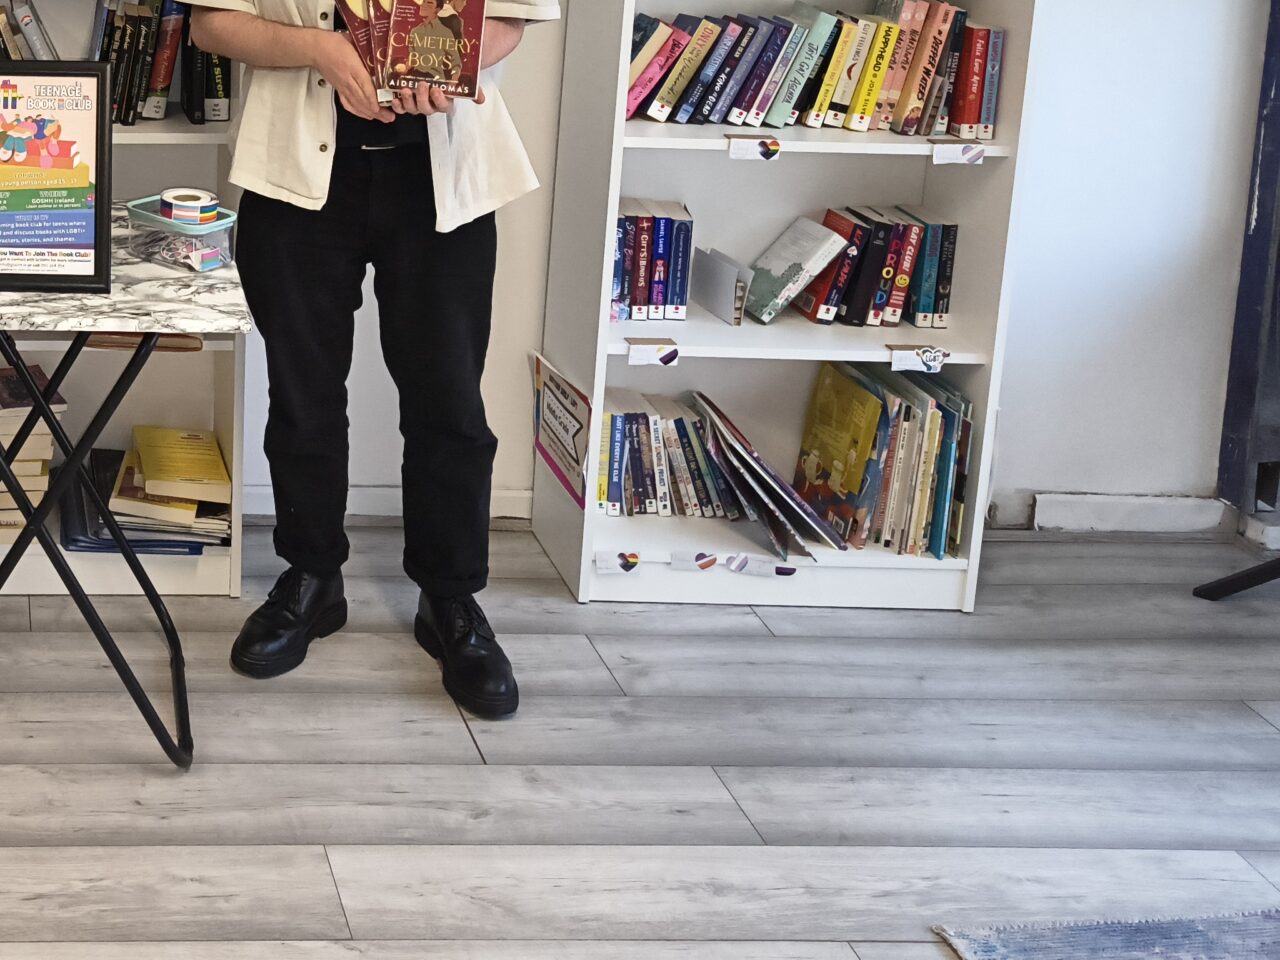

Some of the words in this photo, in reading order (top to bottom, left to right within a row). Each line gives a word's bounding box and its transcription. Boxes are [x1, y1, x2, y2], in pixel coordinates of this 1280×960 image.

[391, 32, 476, 53] CEMETERY
[693, 25, 714, 50] ONLY
[870, 25, 893, 72] HAPPYHEAD
[930, 34, 943, 71] DEEPER
[974, 39, 984, 57] Felix
[409, 52, 452, 70] BOYS
[794, 60, 809, 78] GAY
[972, 57, 982, 73] Ever
[34, 84, 82, 97] TEENAGE
[712, 72, 728, 92] KING
[781, 75, 802, 106] AGENDA
[865, 78, 876, 97] JOSH
[917, 65, 934, 102] WATERS
[27, 97, 55, 110] BOOK
[64, 98, 93, 110] CLUB
[700, 94, 716, 115] DEAD
[908, 225, 919, 246] GAY
[901, 245, 914, 271] CLUB!
[638, 278, 645, 286] US
[614, 415, 622, 429] JUST
